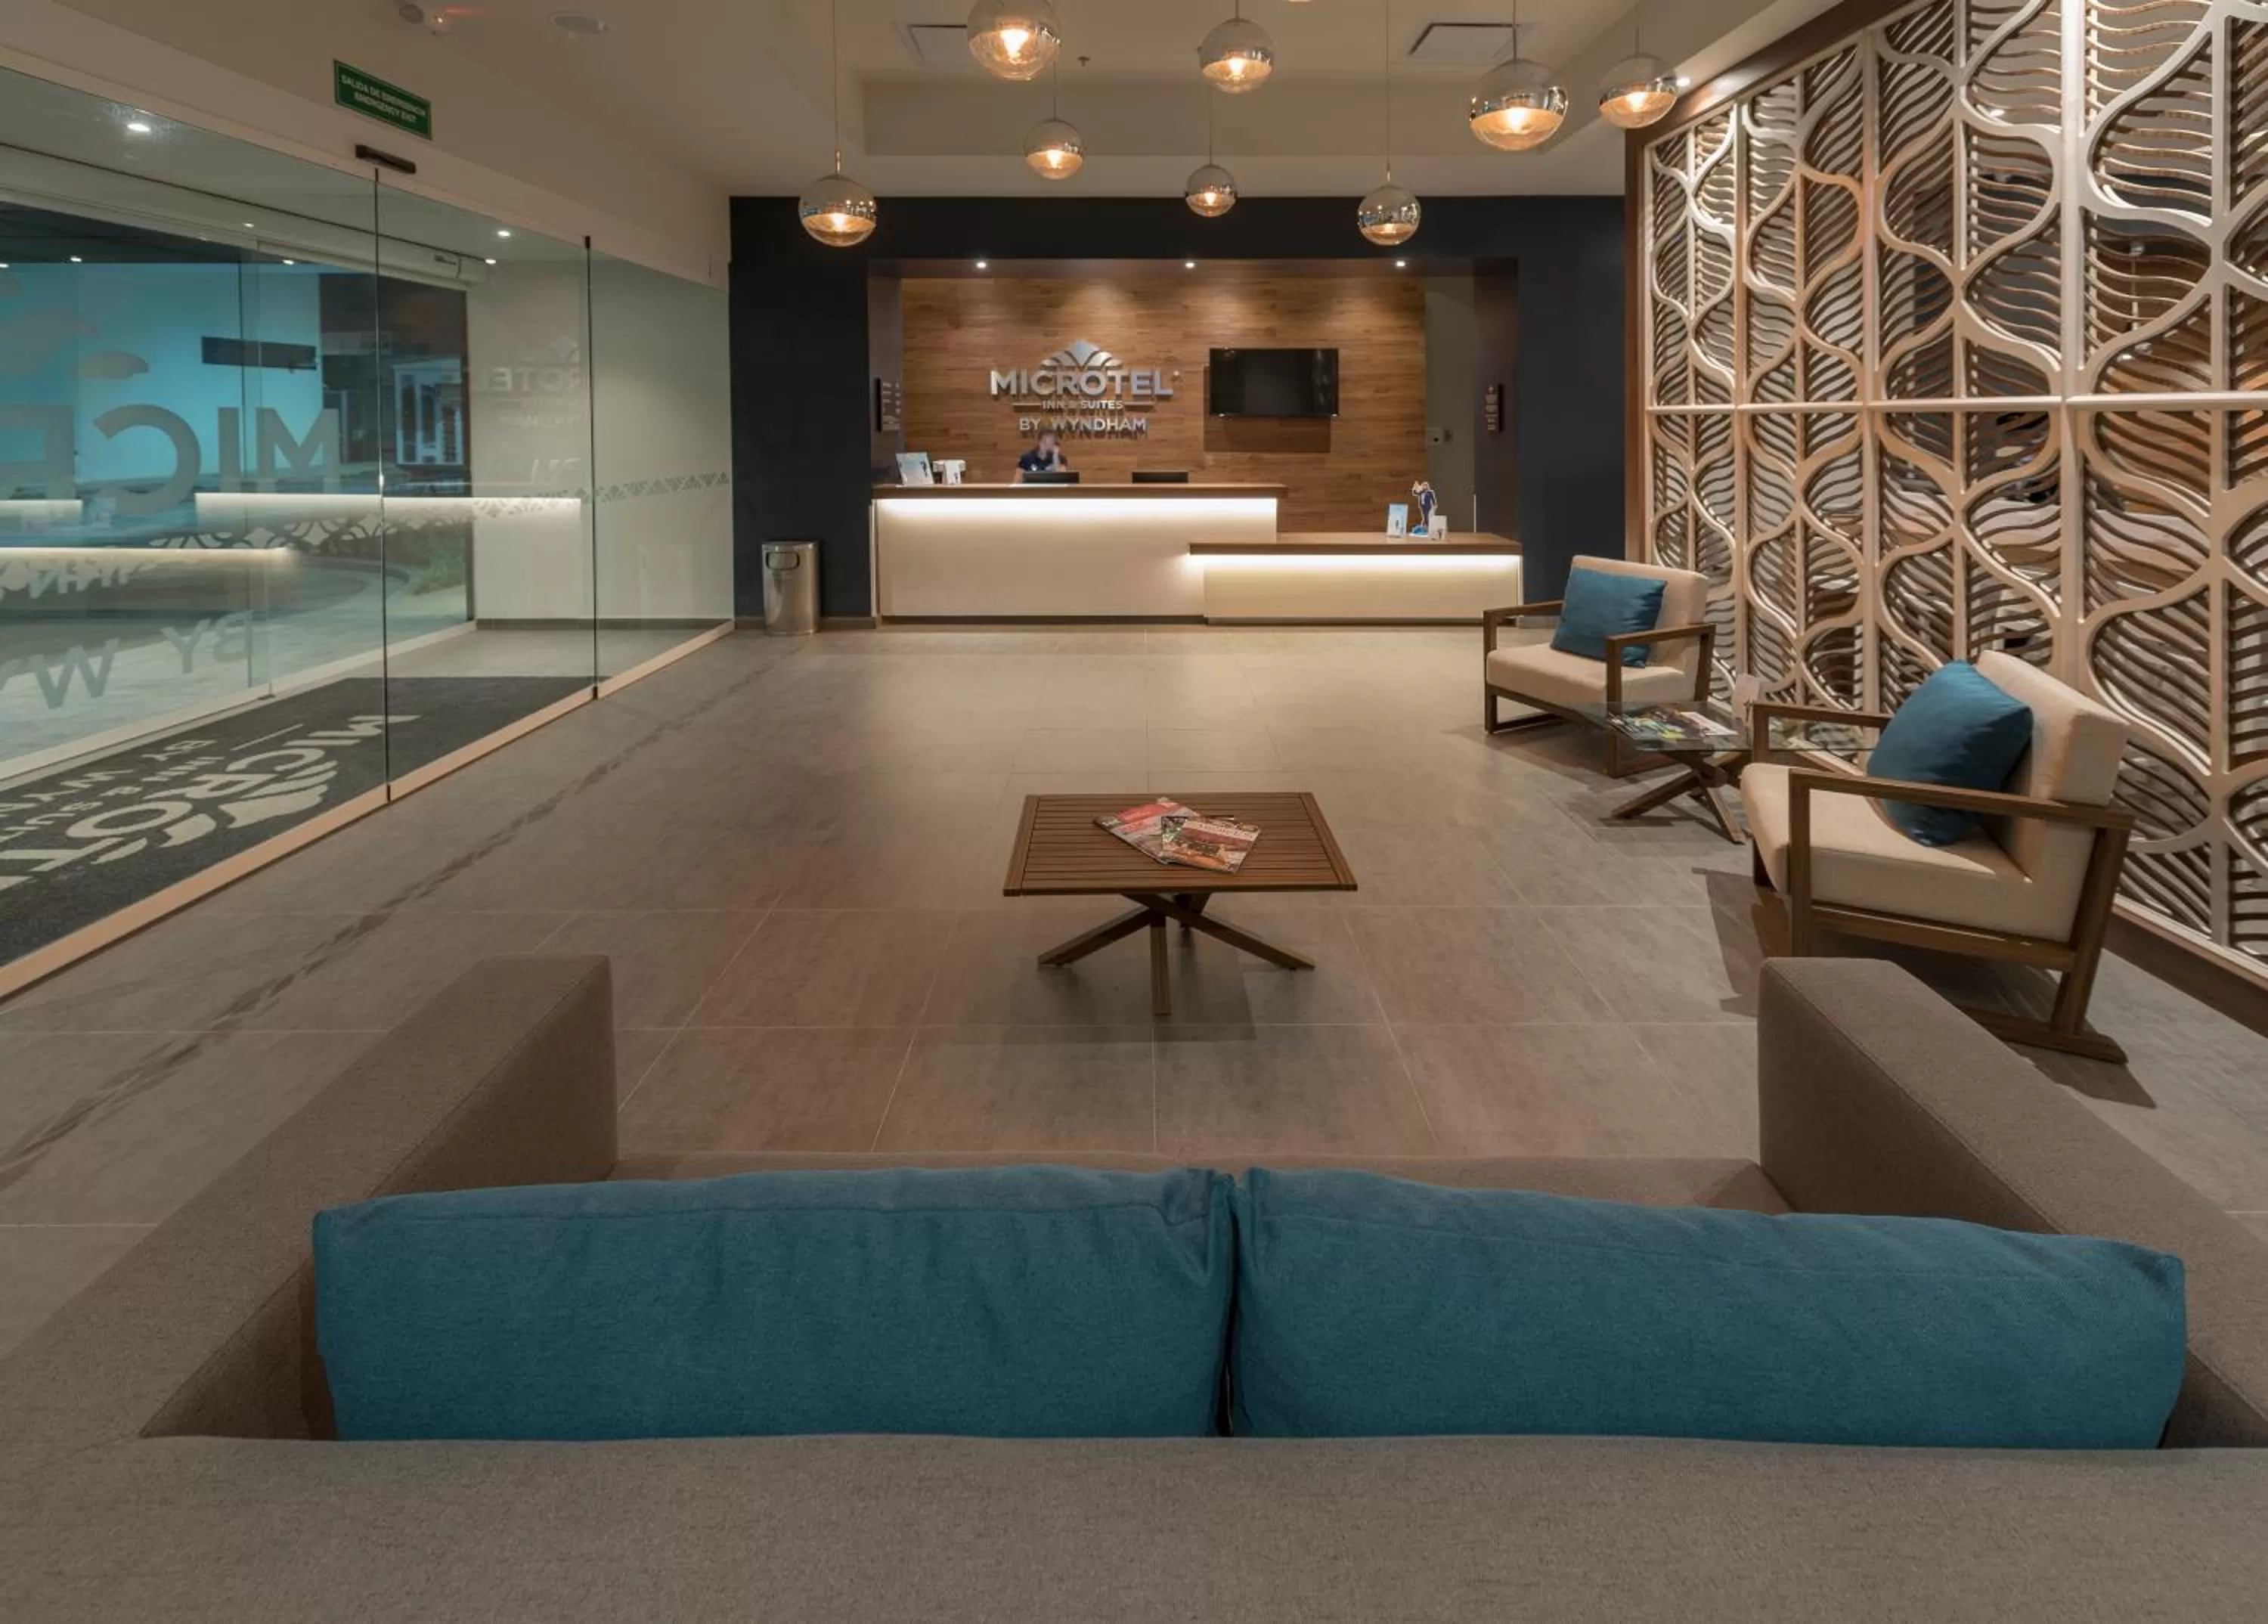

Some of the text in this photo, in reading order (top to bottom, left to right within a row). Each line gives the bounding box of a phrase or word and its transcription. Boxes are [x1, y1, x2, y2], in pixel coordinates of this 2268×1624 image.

[990, 369, 1173, 396] MICROTEL
[1043, 400, 1064, 410] INN
[1080, 399, 1124, 410] SUITES
[1019, 417, 1147, 432] BY WYNDHAM
